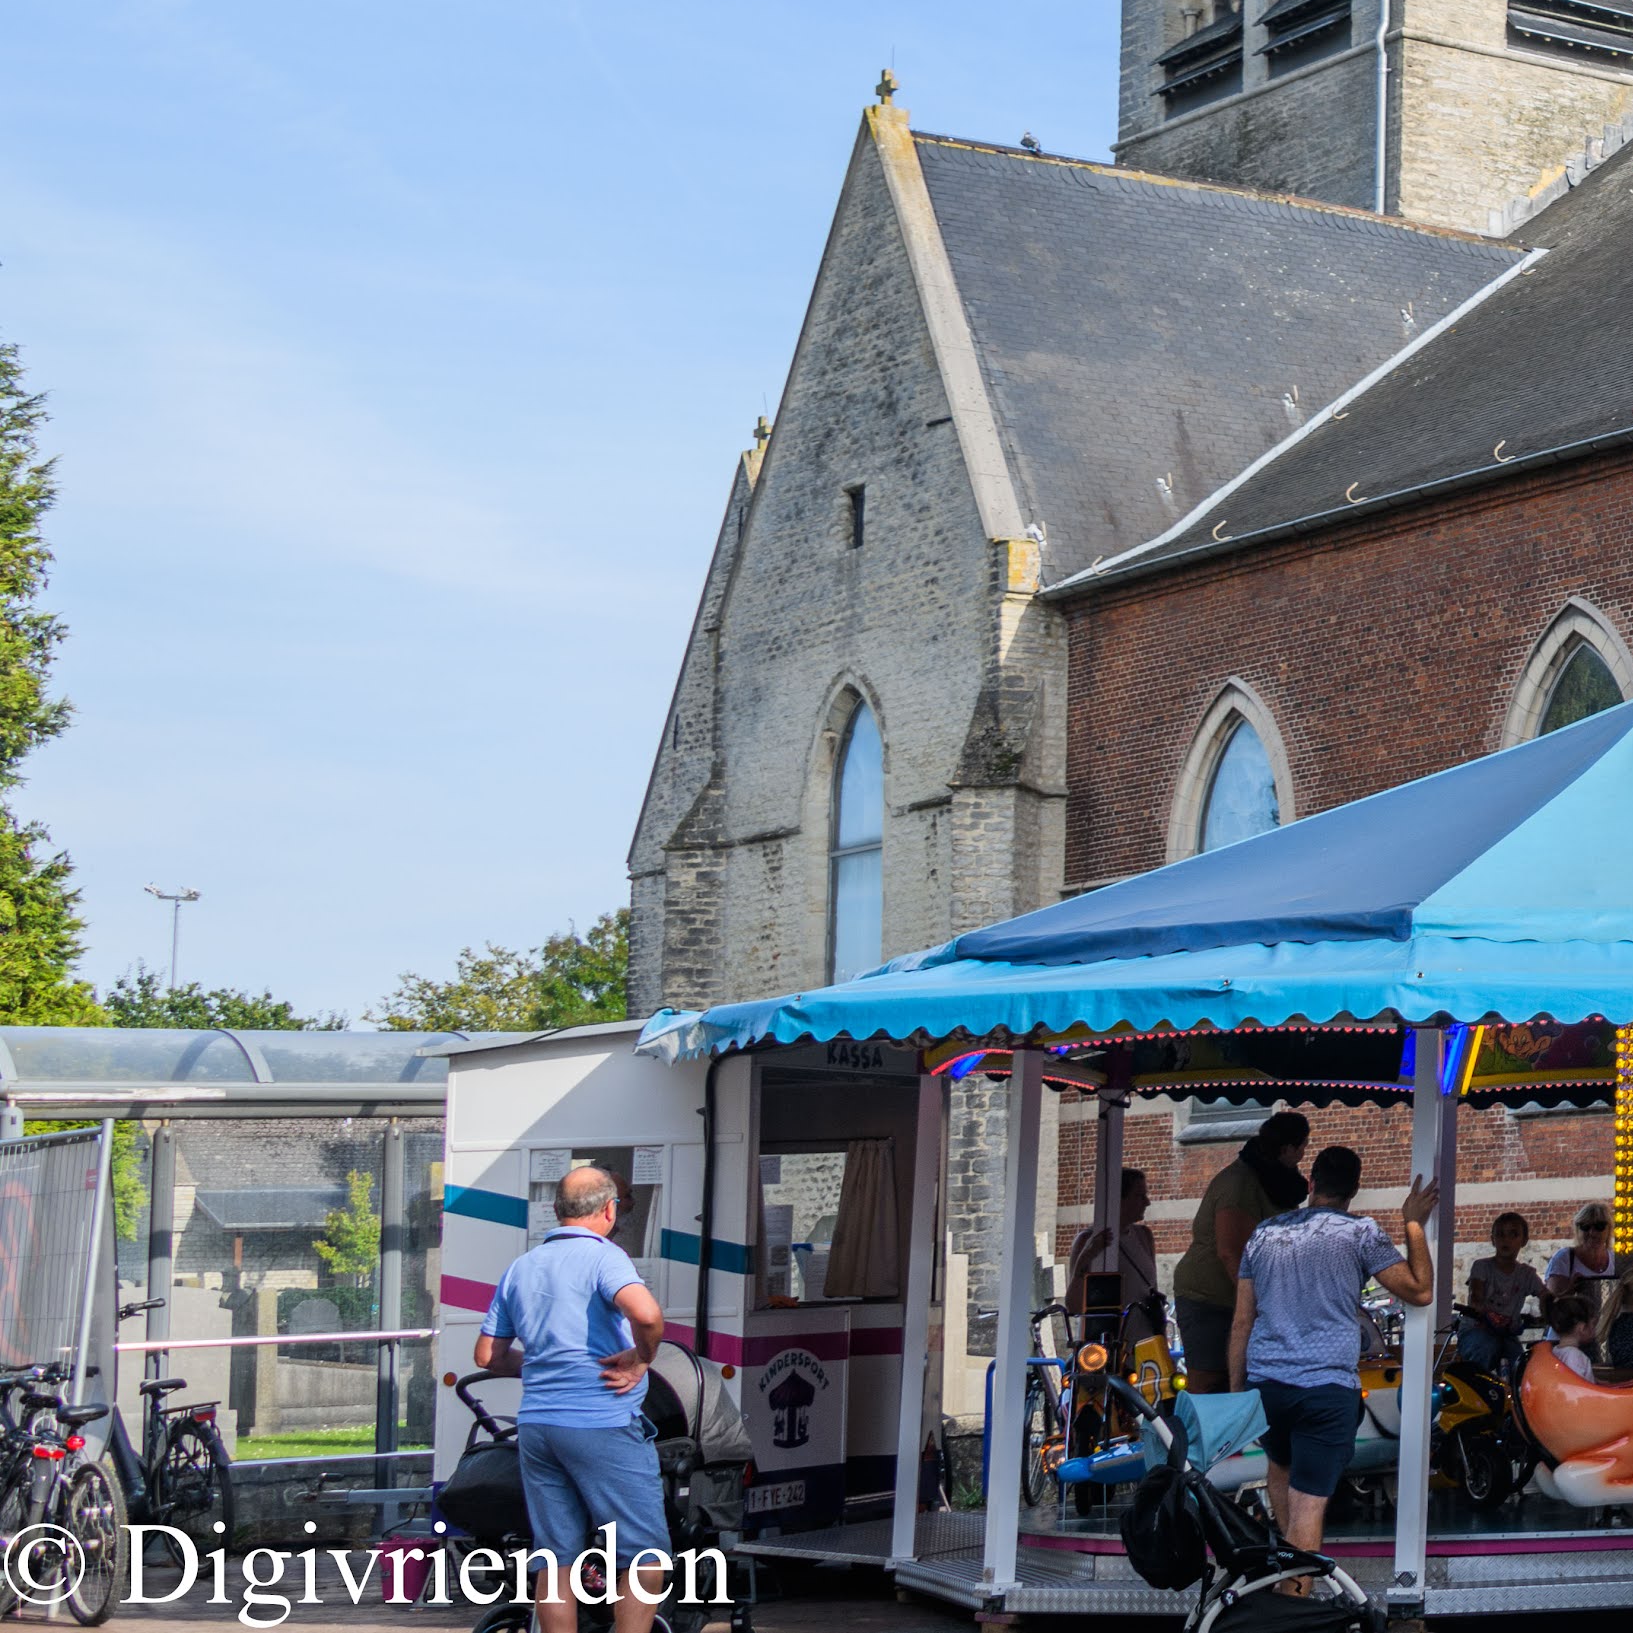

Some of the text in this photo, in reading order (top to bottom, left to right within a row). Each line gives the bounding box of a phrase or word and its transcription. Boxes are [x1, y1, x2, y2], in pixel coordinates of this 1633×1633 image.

[827, 1042, 883, 1068] KASSA
[758, 1352, 830, 1392] KINDERSPORT
[1488, 1389, 1499, 1401] 9
[751, 1483, 804, 1509] 1-FYE-242
